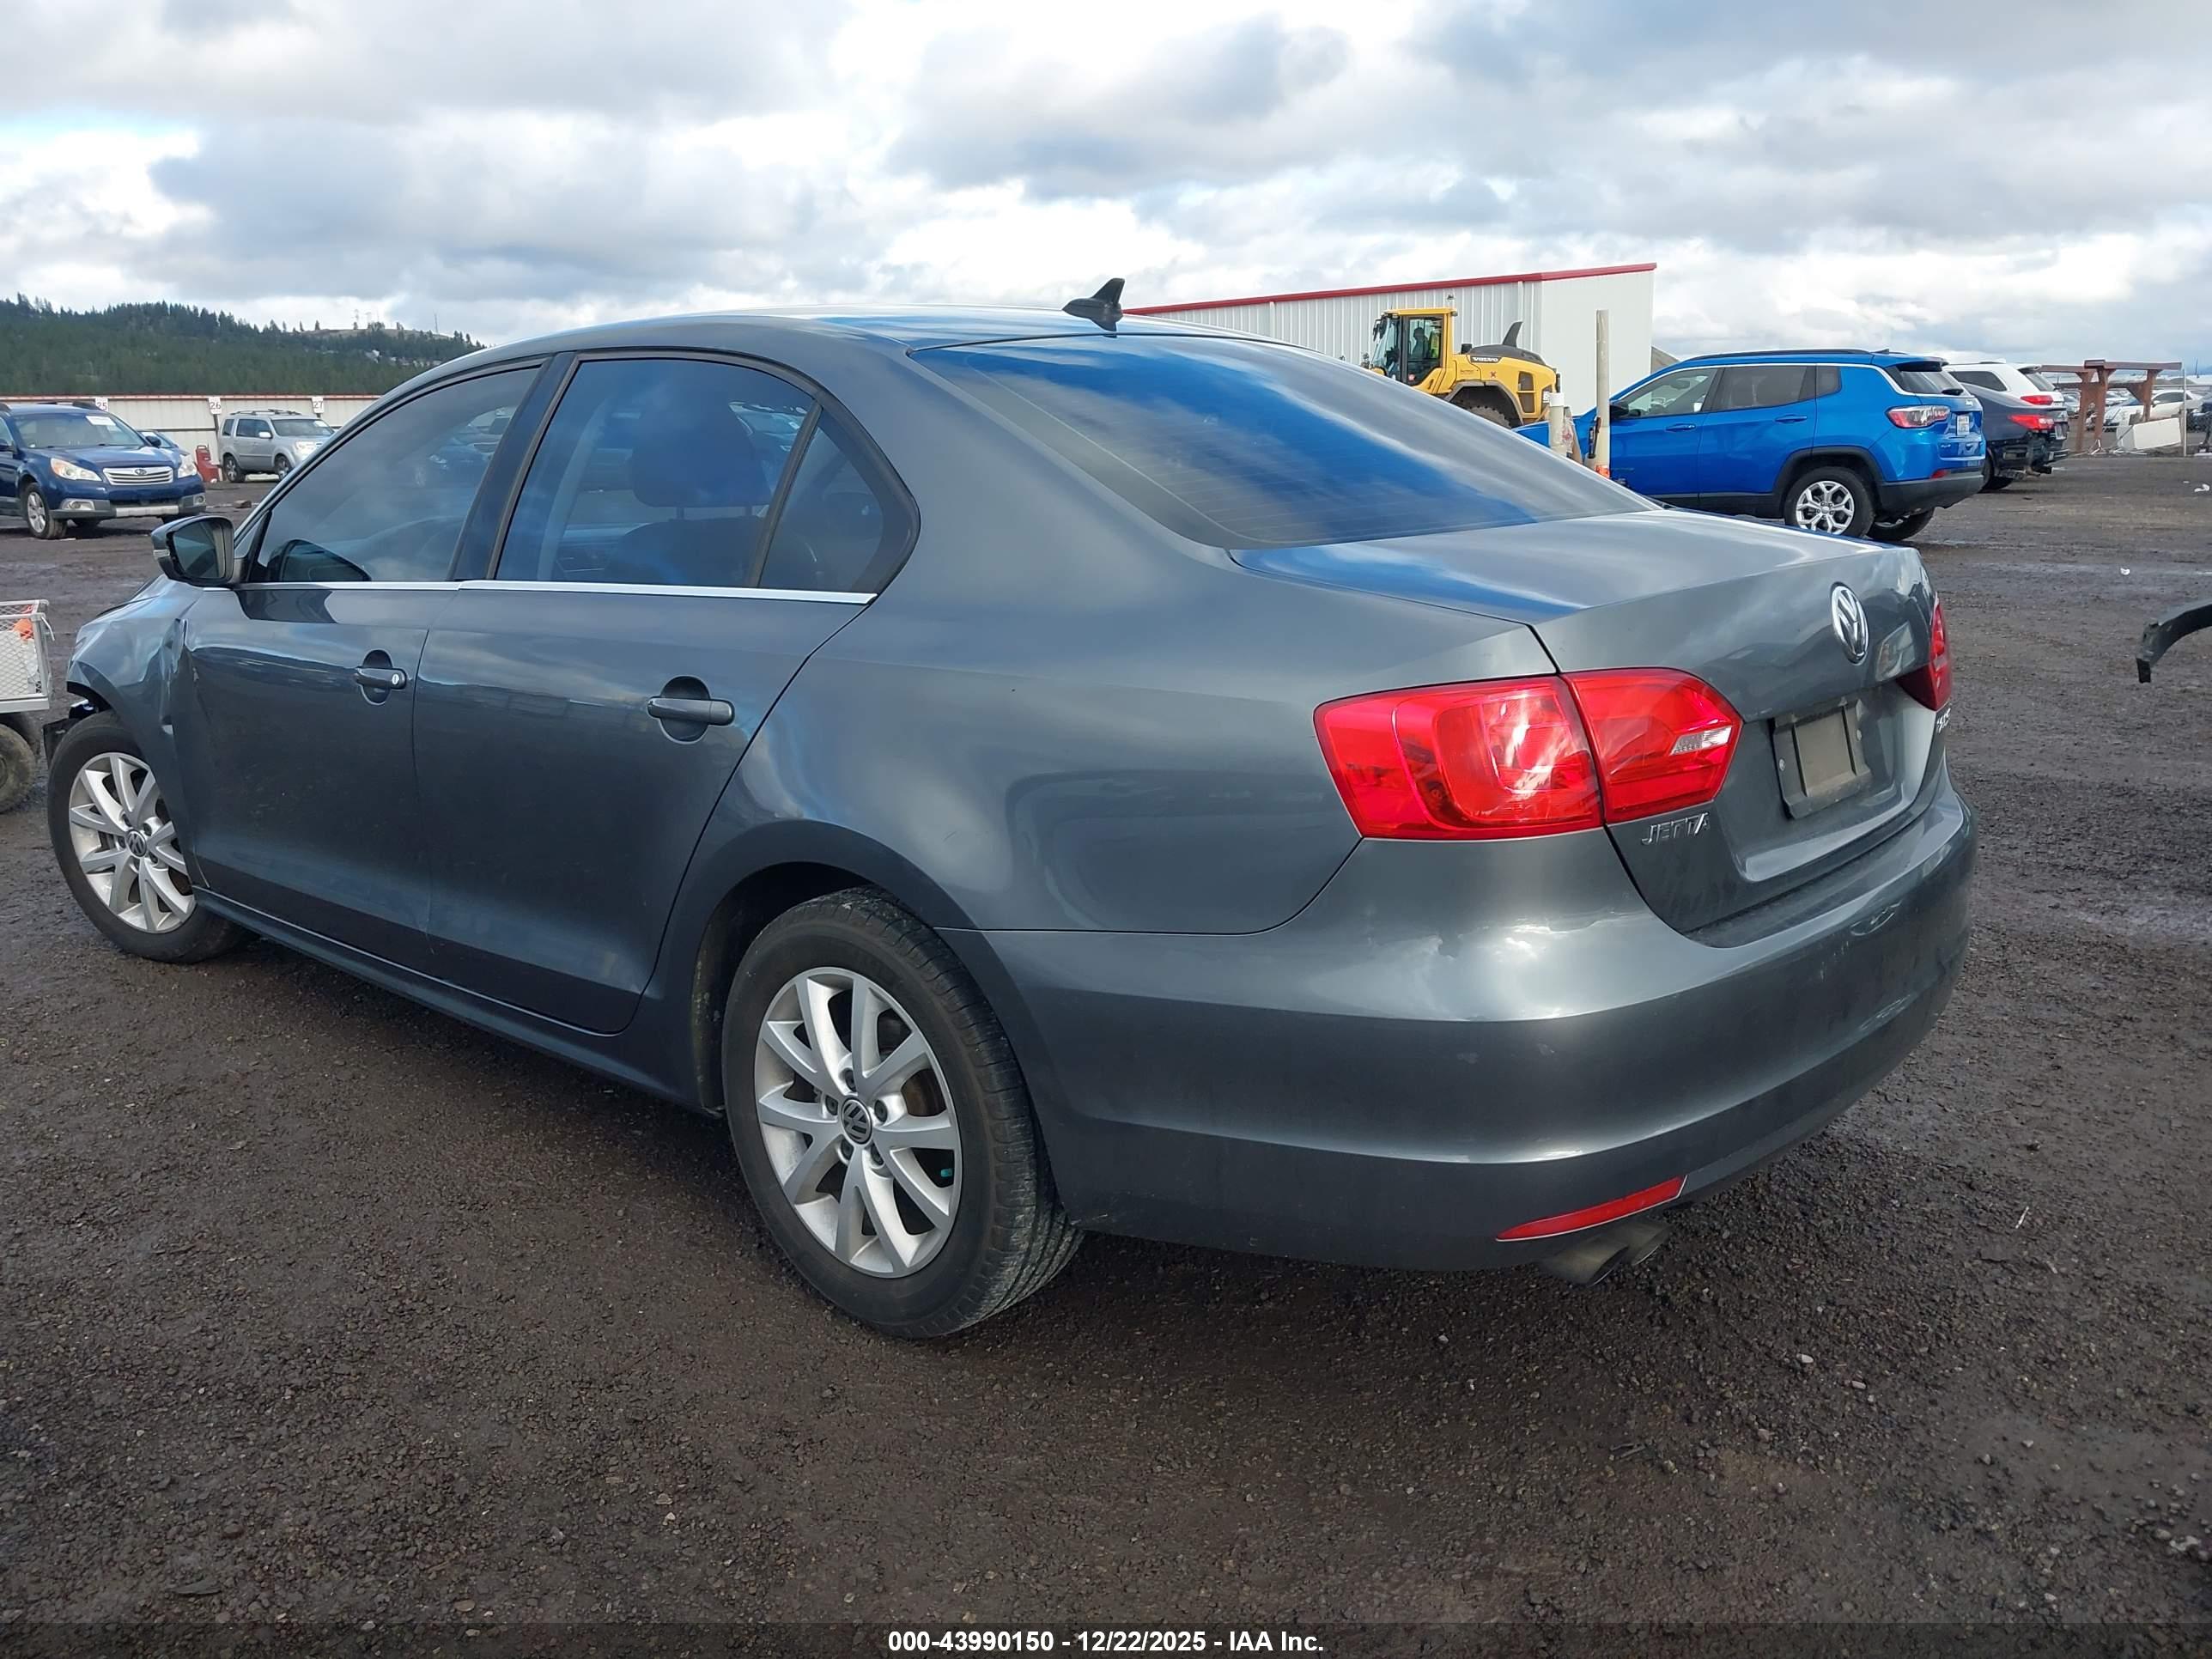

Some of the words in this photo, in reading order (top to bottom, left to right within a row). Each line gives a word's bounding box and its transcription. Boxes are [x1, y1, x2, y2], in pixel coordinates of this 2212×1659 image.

[210, 401, 222, 410] 26
[313, 400, 324, 409] 27
[1641, 811, 1711, 845] JETTA
